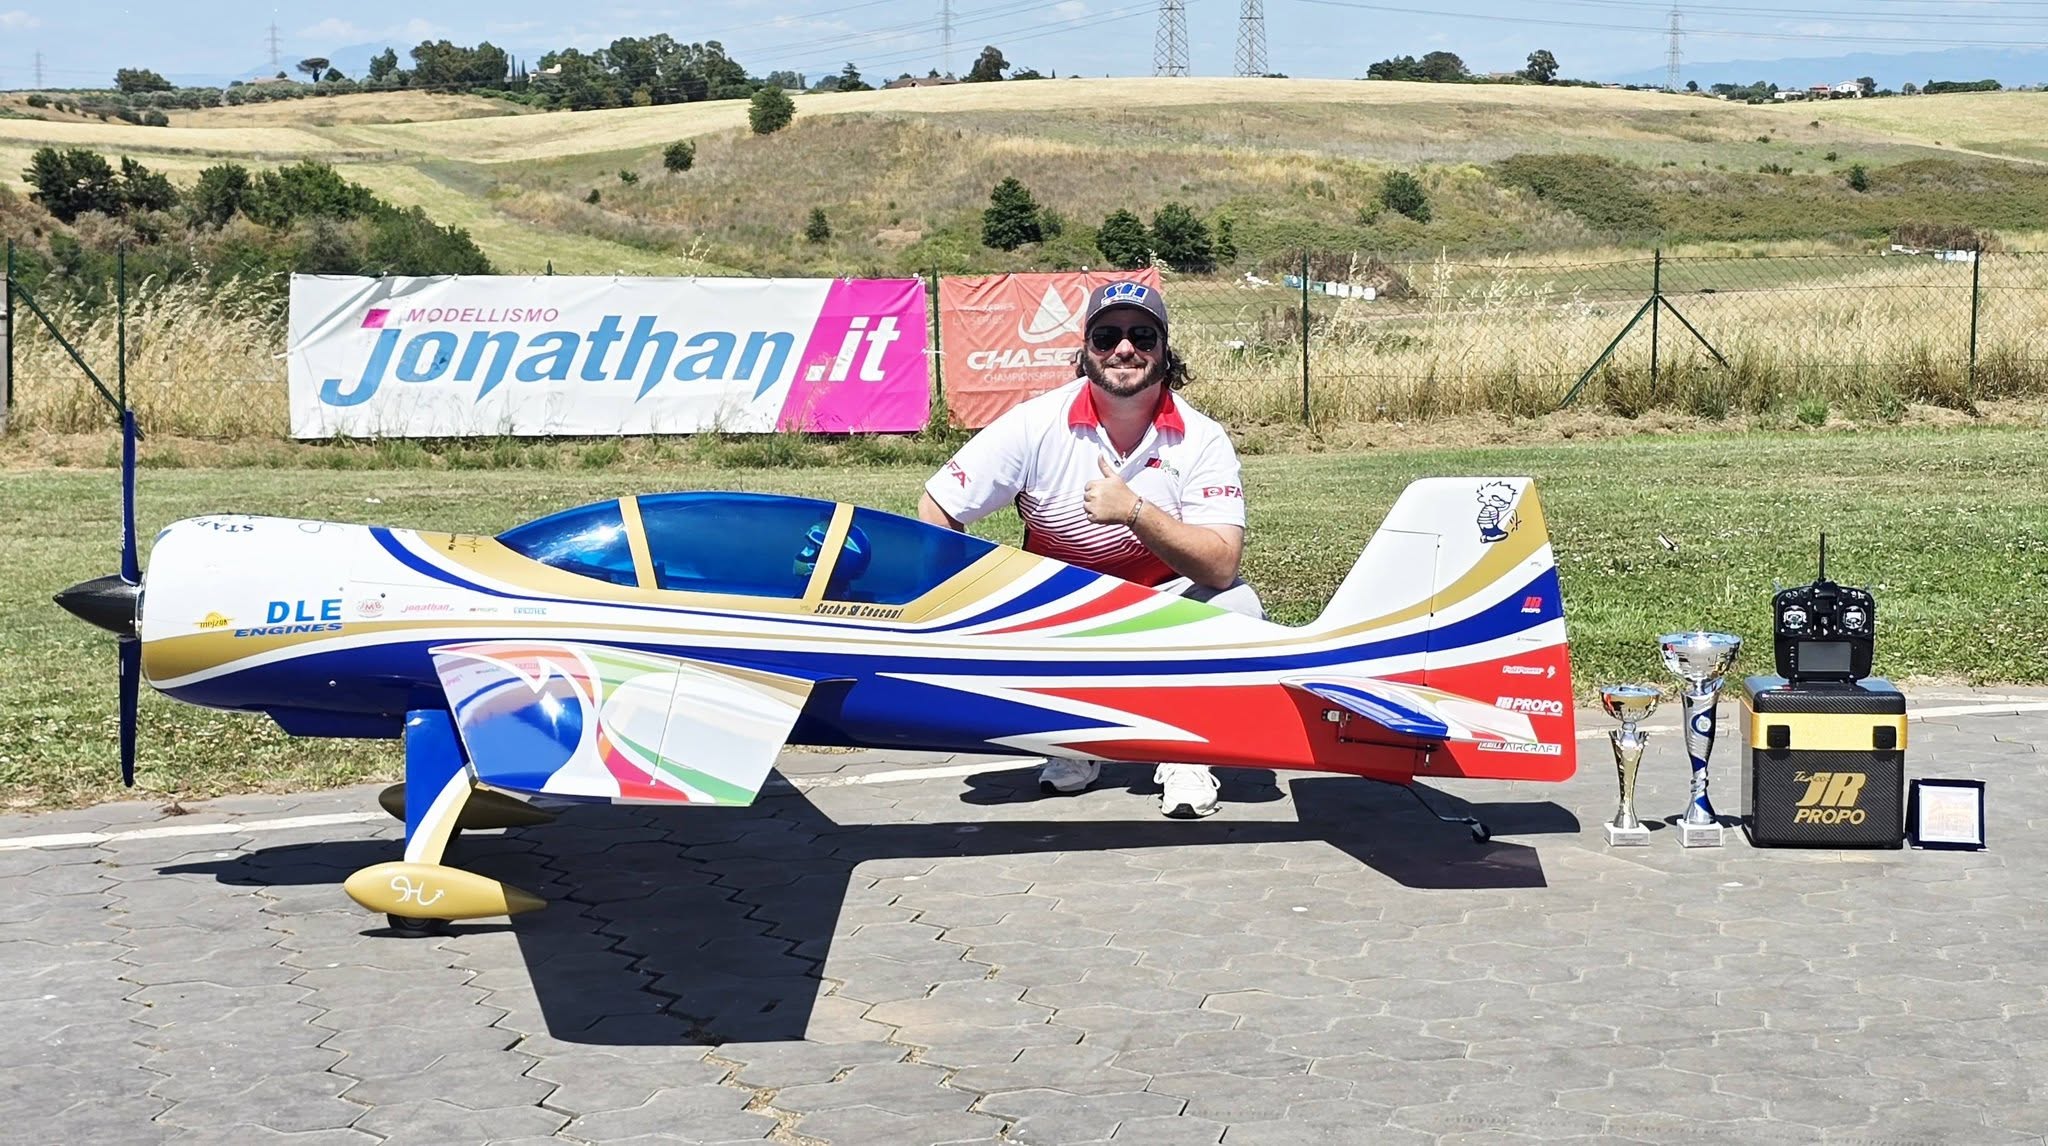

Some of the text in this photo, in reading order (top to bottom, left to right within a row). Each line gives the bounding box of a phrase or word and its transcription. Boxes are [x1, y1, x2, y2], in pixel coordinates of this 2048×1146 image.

[407, 308, 559, 323] MODELLISMO
[984, 371, 1055, 383] CHAMPIONSHIP
[266, 599, 343, 624] DLE
[814, 603, 847, 615] Sacha
[234, 622, 343, 638] ENGINES
[1511, 698, 1563, 713] PROPO
[1505, 742, 1560, 754] AIRCRAFT
[1795, 772, 1867, 807] JR
[1793, 809, 1866, 825] PROPO
